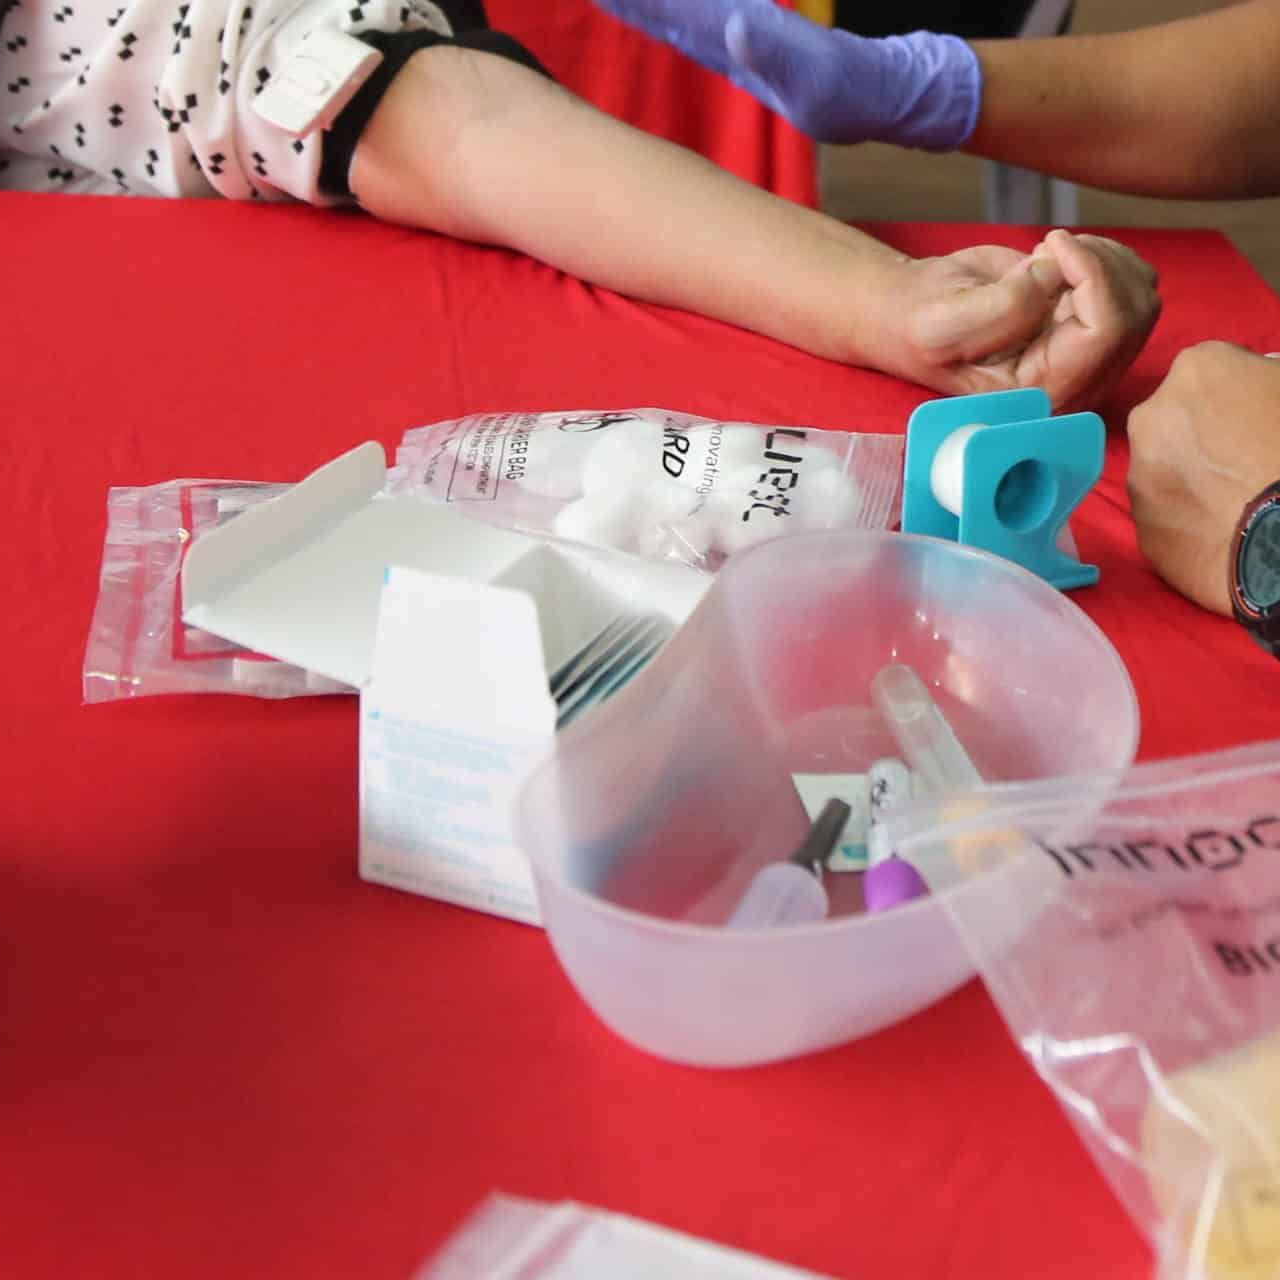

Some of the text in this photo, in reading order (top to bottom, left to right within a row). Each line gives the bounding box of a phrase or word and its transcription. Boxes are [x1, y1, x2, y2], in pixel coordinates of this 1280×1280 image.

[506, 457, 527, 480] BAG
[662, 417, 690, 478] RD
[695, 423, 723, 494] novating
[741, 427, 808, 522] uest
